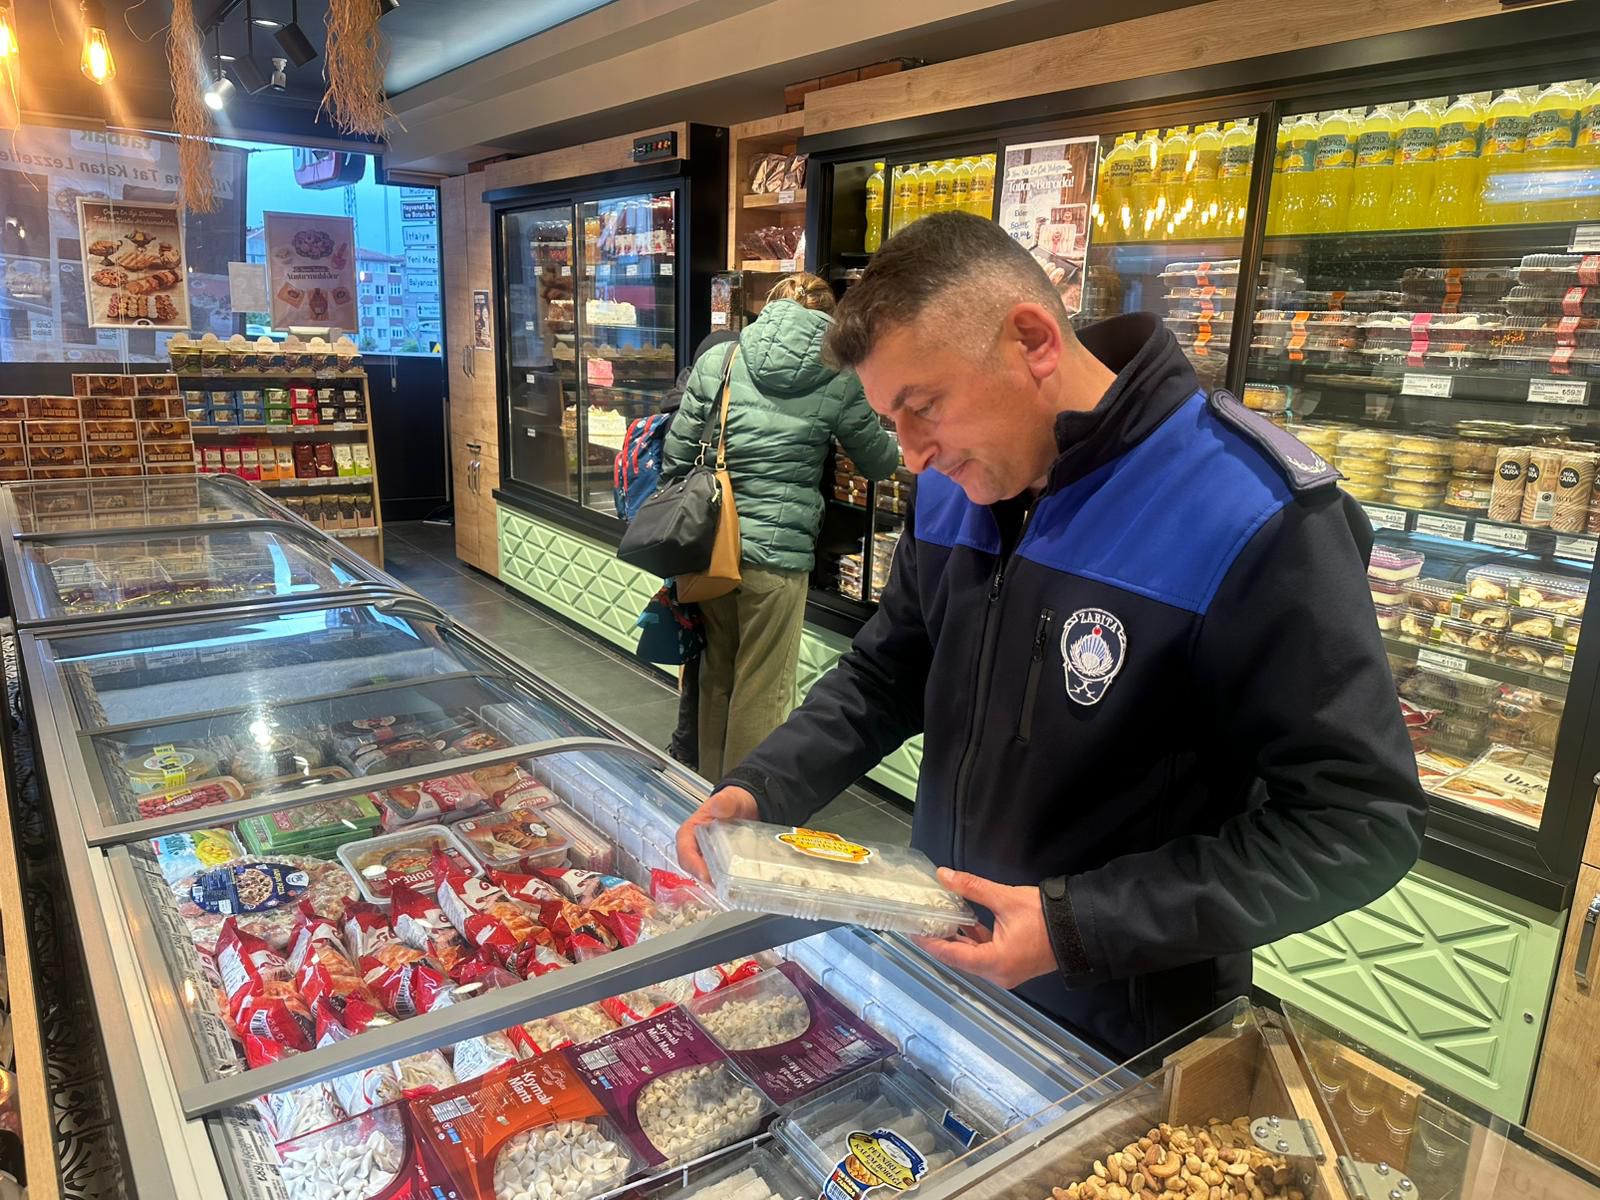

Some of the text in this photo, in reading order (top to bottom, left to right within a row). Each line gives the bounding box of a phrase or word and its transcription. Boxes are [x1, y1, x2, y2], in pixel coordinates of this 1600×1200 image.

[1037, 176, 1075, 190] Burada!
[407, 255, 420, 264] Yeni
[1501, 468, 1519, 476] CARA
[1560, 475, 1578, 484] CARA
[1079, 612, 1117, 633] ZABITA
[646, 1027, 676, 1059] Mini Mantı
[656, 1022, 680, 1046] Kıymalı
[507, 1076, 532, 1104] Mantı
[521, 1070, 554, 1105] Kıymalı
[854, 1143, 876, 1167] KALEM
